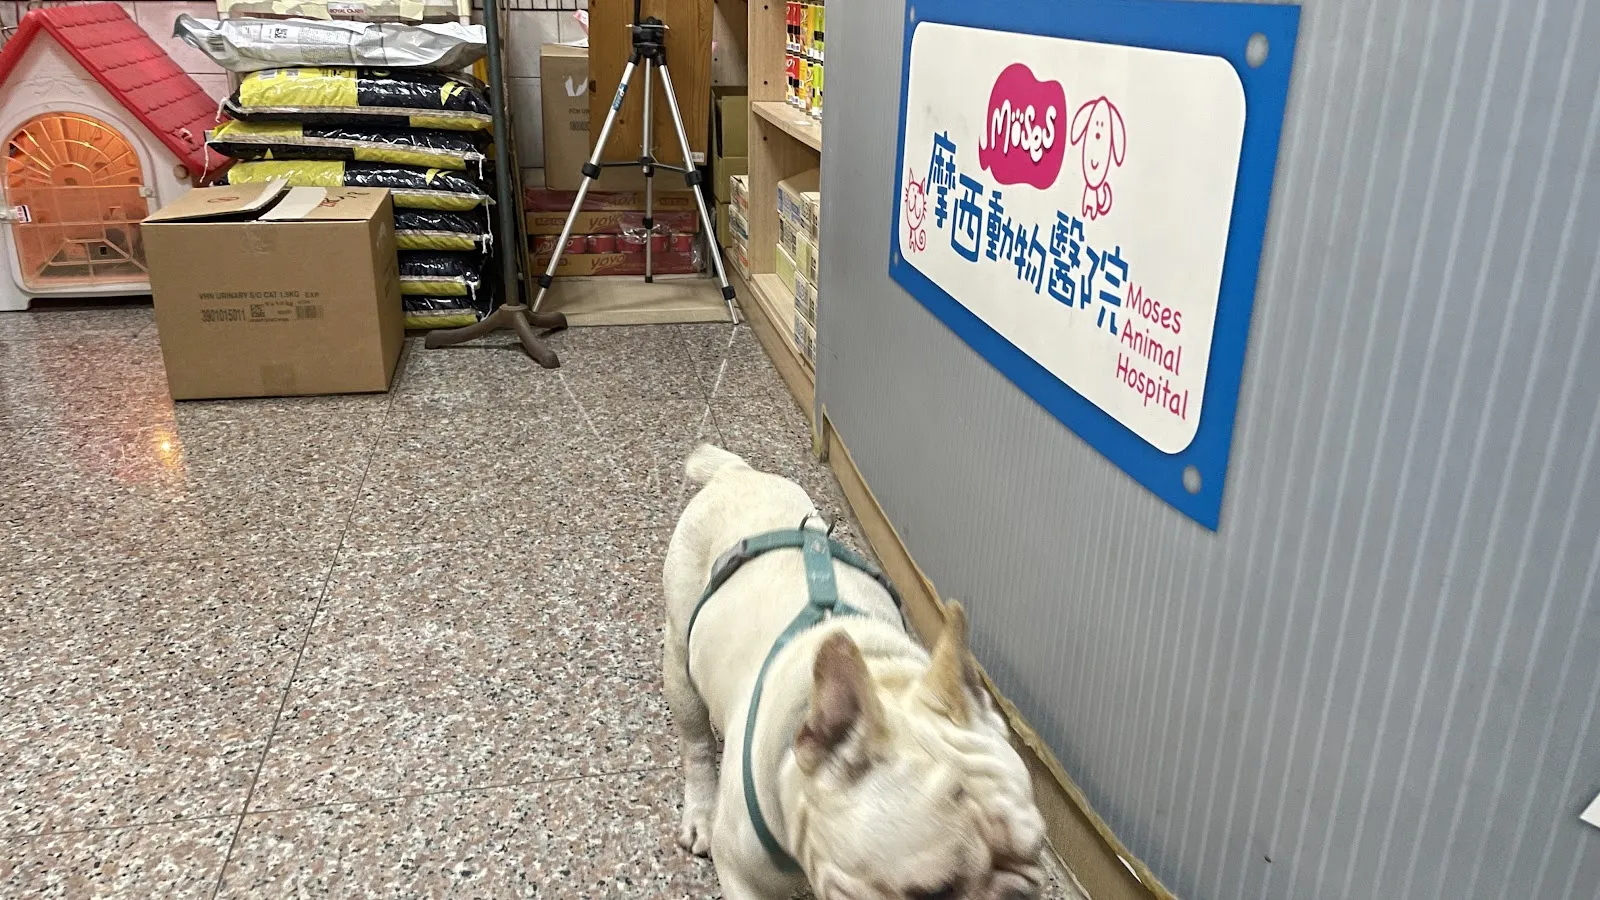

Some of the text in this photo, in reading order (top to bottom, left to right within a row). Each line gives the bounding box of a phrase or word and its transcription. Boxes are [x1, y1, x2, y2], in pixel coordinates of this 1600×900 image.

[927, 131, 1128, 335] 摩西動物醫院
[1126, 281, 1182, 334] Moses
[1121, 318, 1182, 376] Animal
[1116, 352, 1189, 421] Hospital
